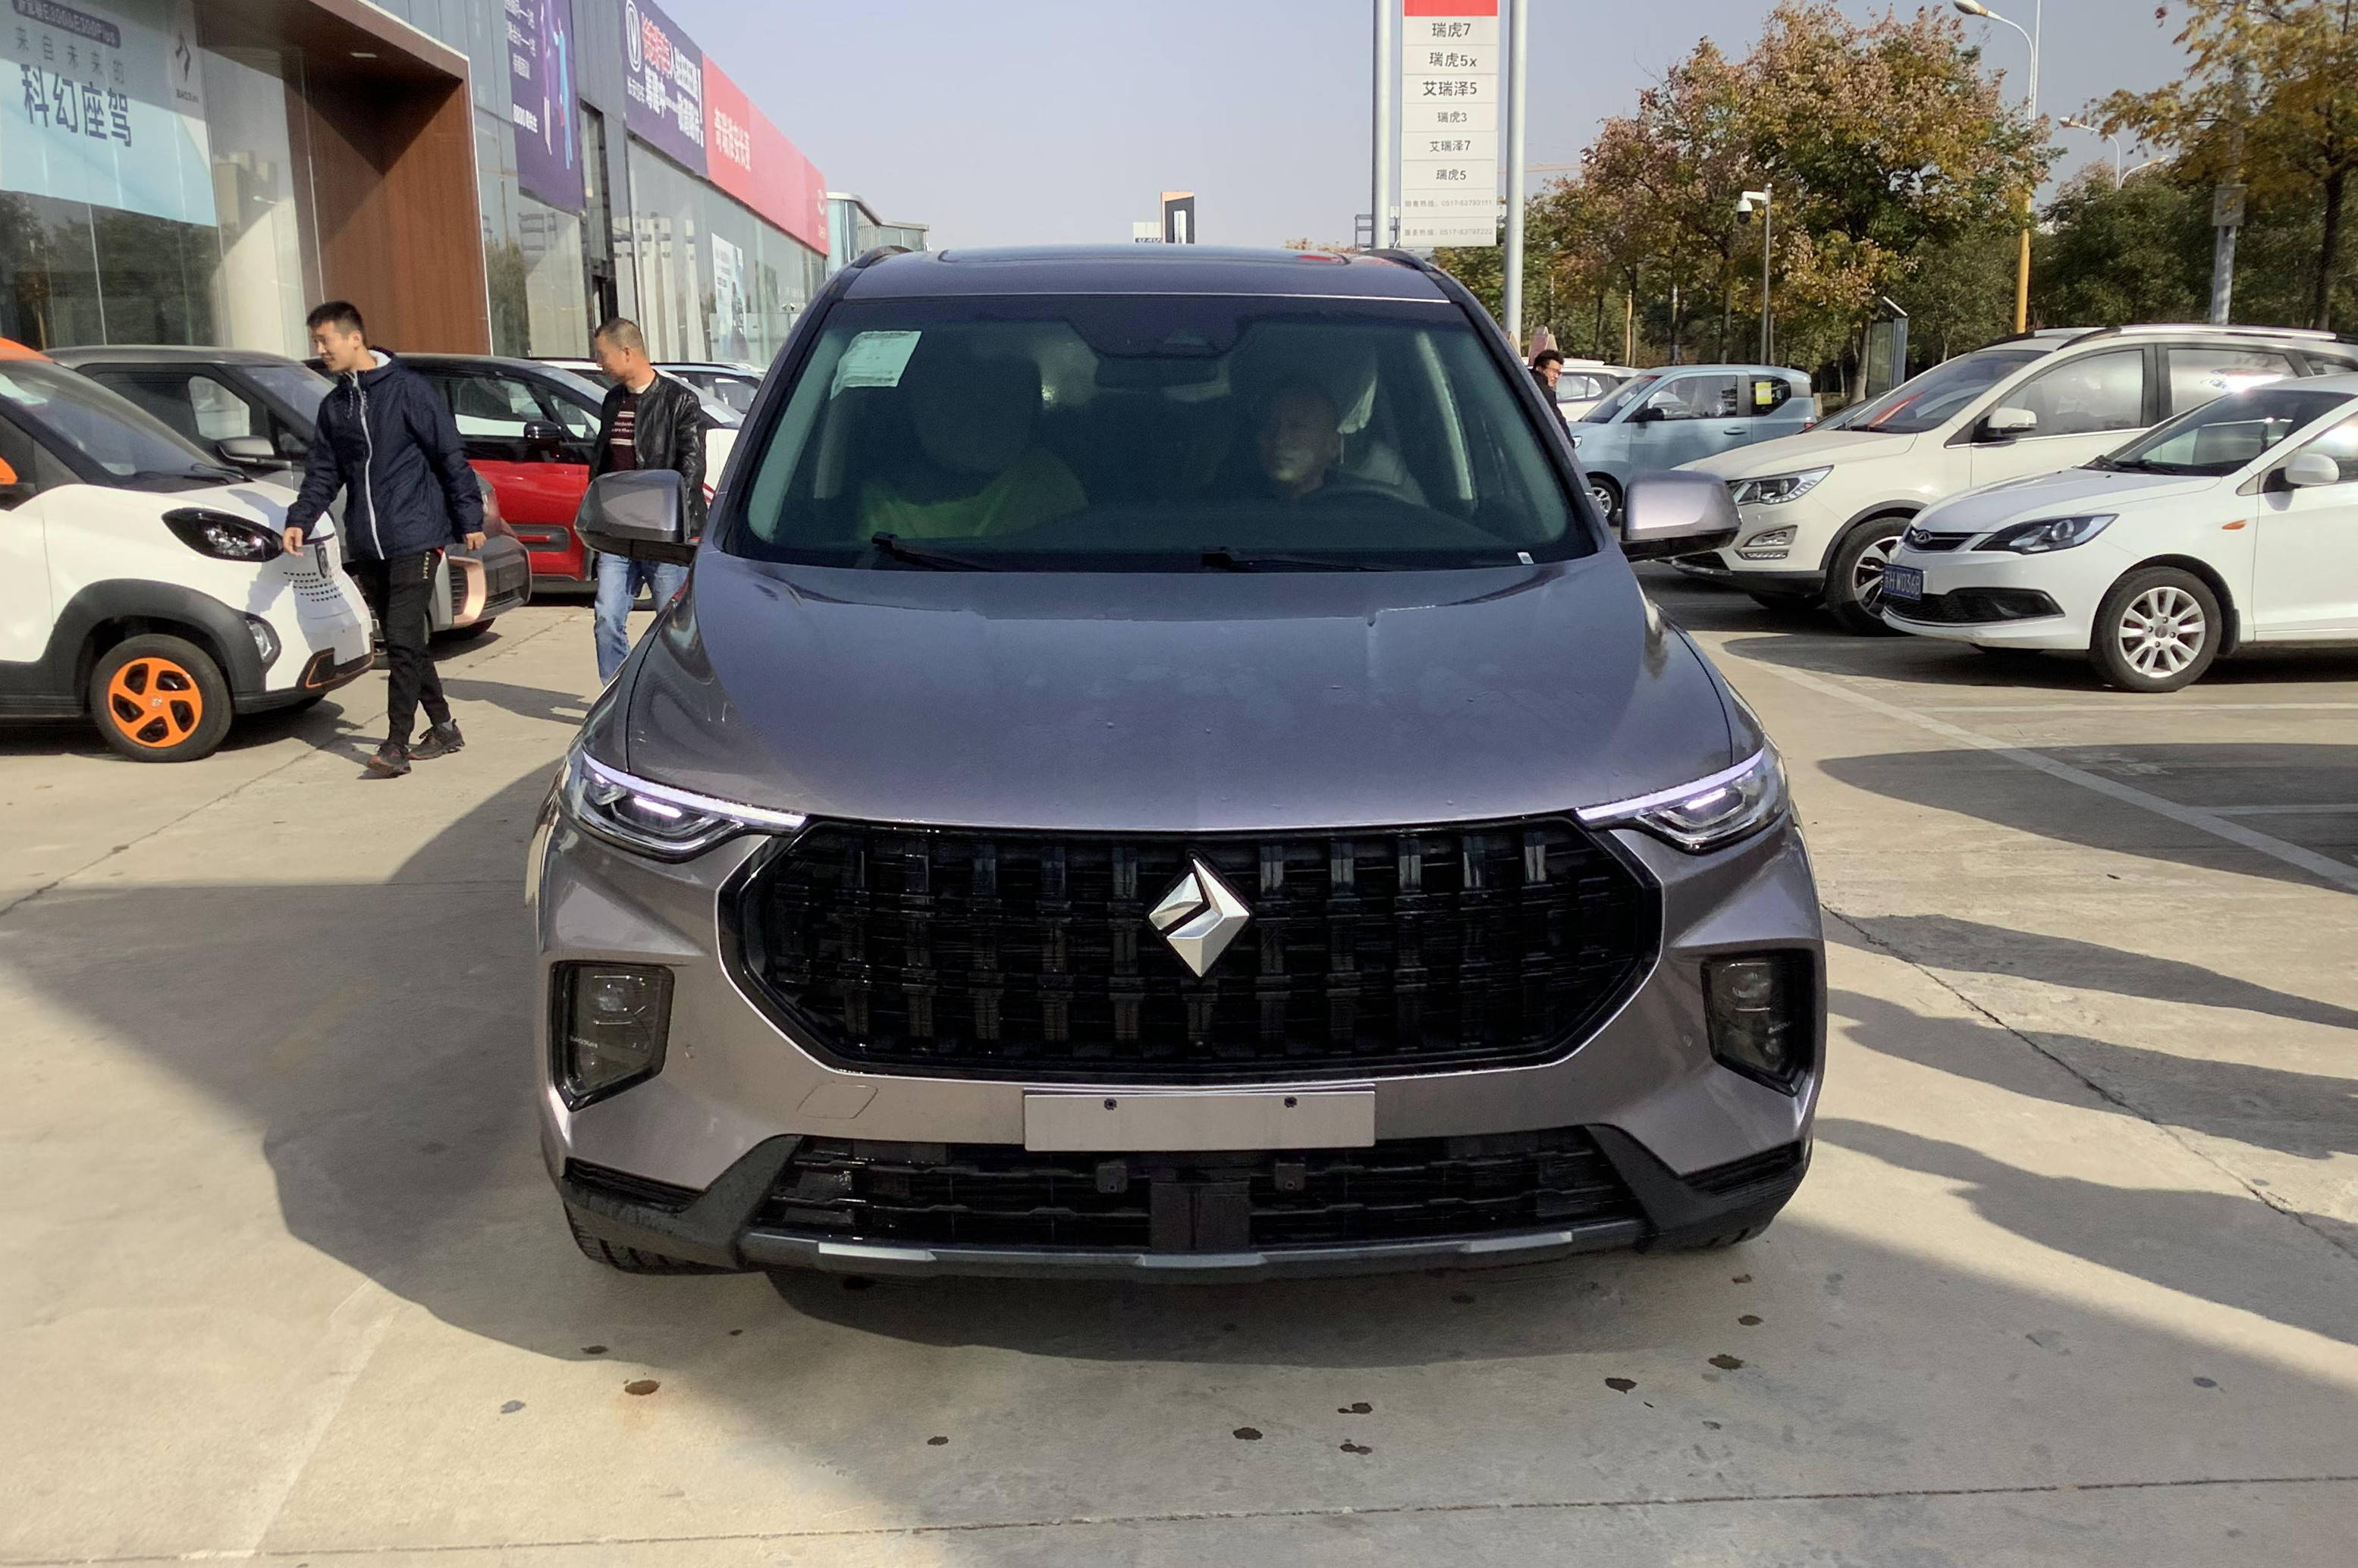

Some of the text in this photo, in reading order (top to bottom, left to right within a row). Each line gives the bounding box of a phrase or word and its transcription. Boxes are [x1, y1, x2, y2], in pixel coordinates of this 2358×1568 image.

[1432, 22, 1471, 38] 瑞虎7
[1429, 52, 1477, 67] 瑞虎5x
[1422, 80, 1477, 96] 艾瑞泽5
[20, 64, 131, 147] 科幻座驾
[1437, 111, 1468, 123] 瑞虎3
[1430, 140, 1471, 152] 艾瑞泽7
[1436, 168, 1467, 180] 瑞虎5
